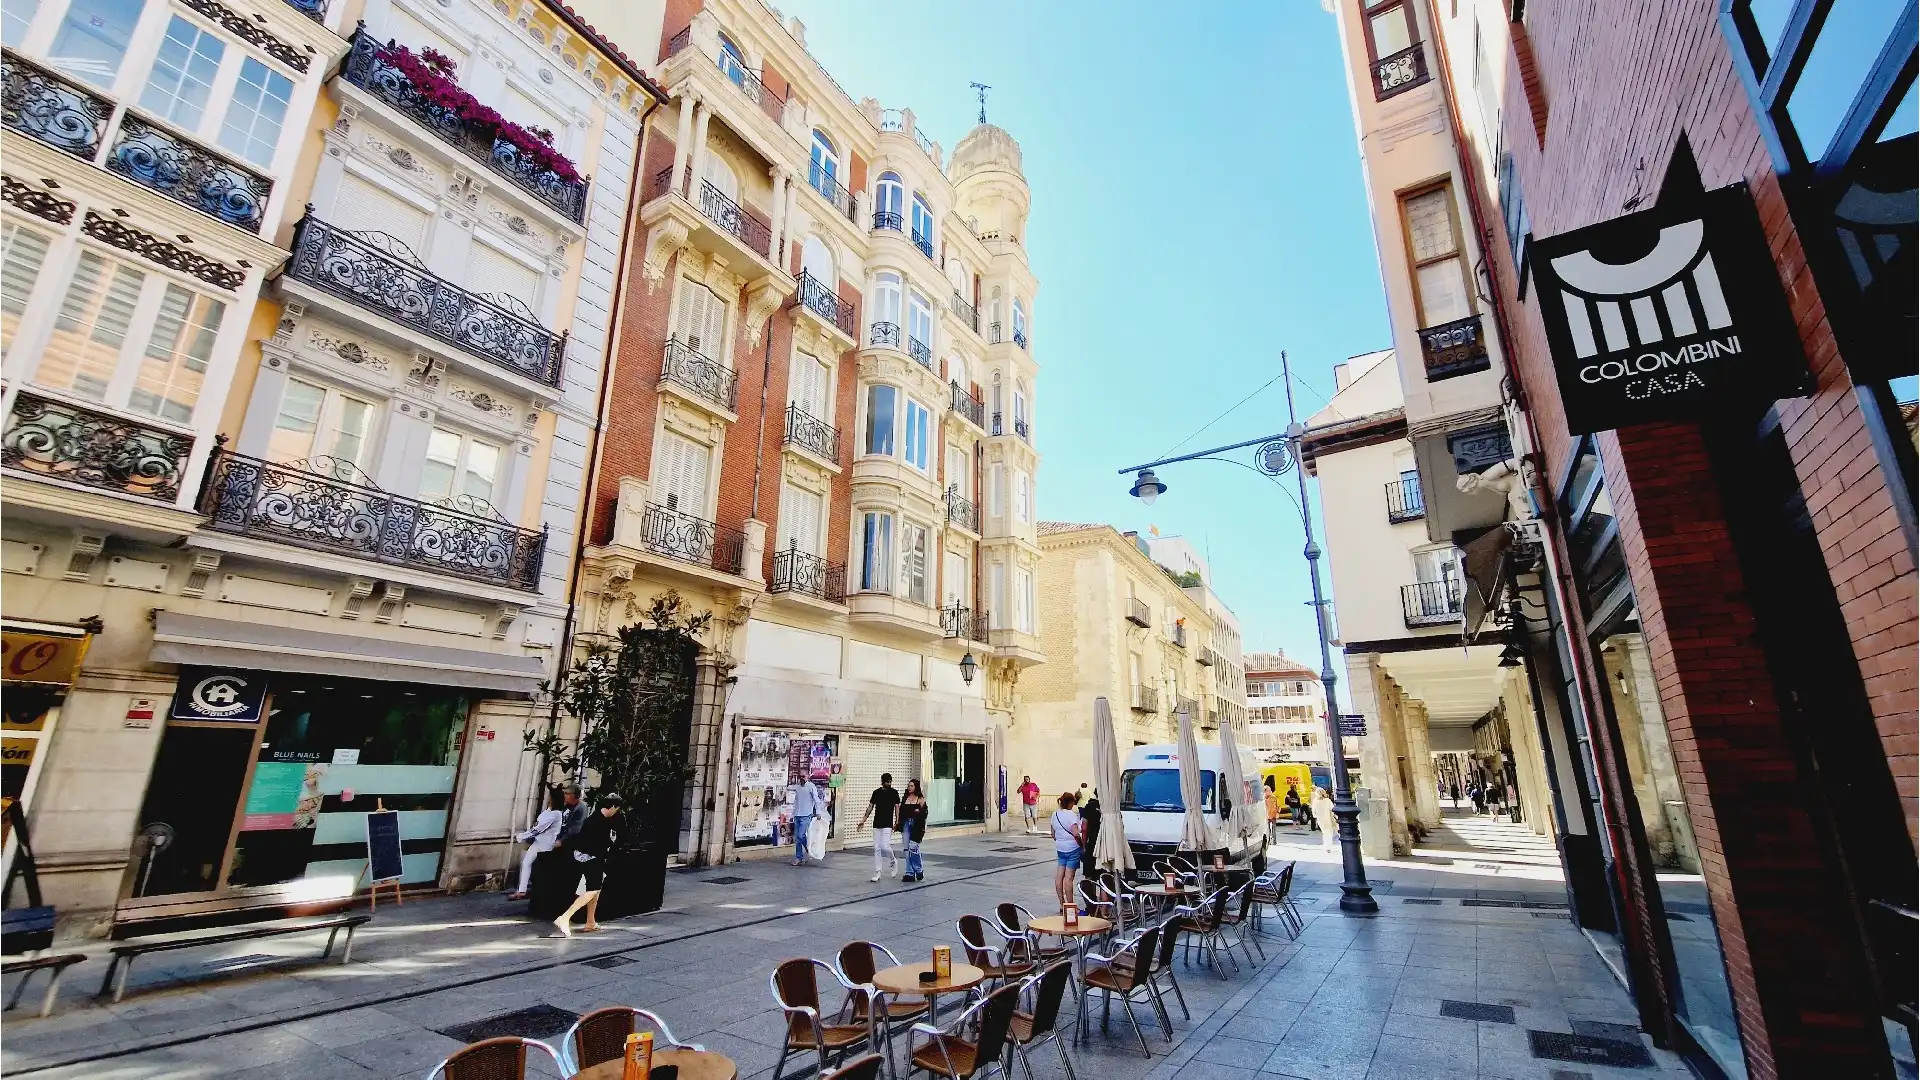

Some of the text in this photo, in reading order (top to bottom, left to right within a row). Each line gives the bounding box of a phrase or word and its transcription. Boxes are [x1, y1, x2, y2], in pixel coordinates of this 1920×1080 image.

[1579, 335, 1742, 383] COLOMBINI
[1625, 370, 1705, 399] CASA
[188, 701, 250, 717] INMOBILIARIA
